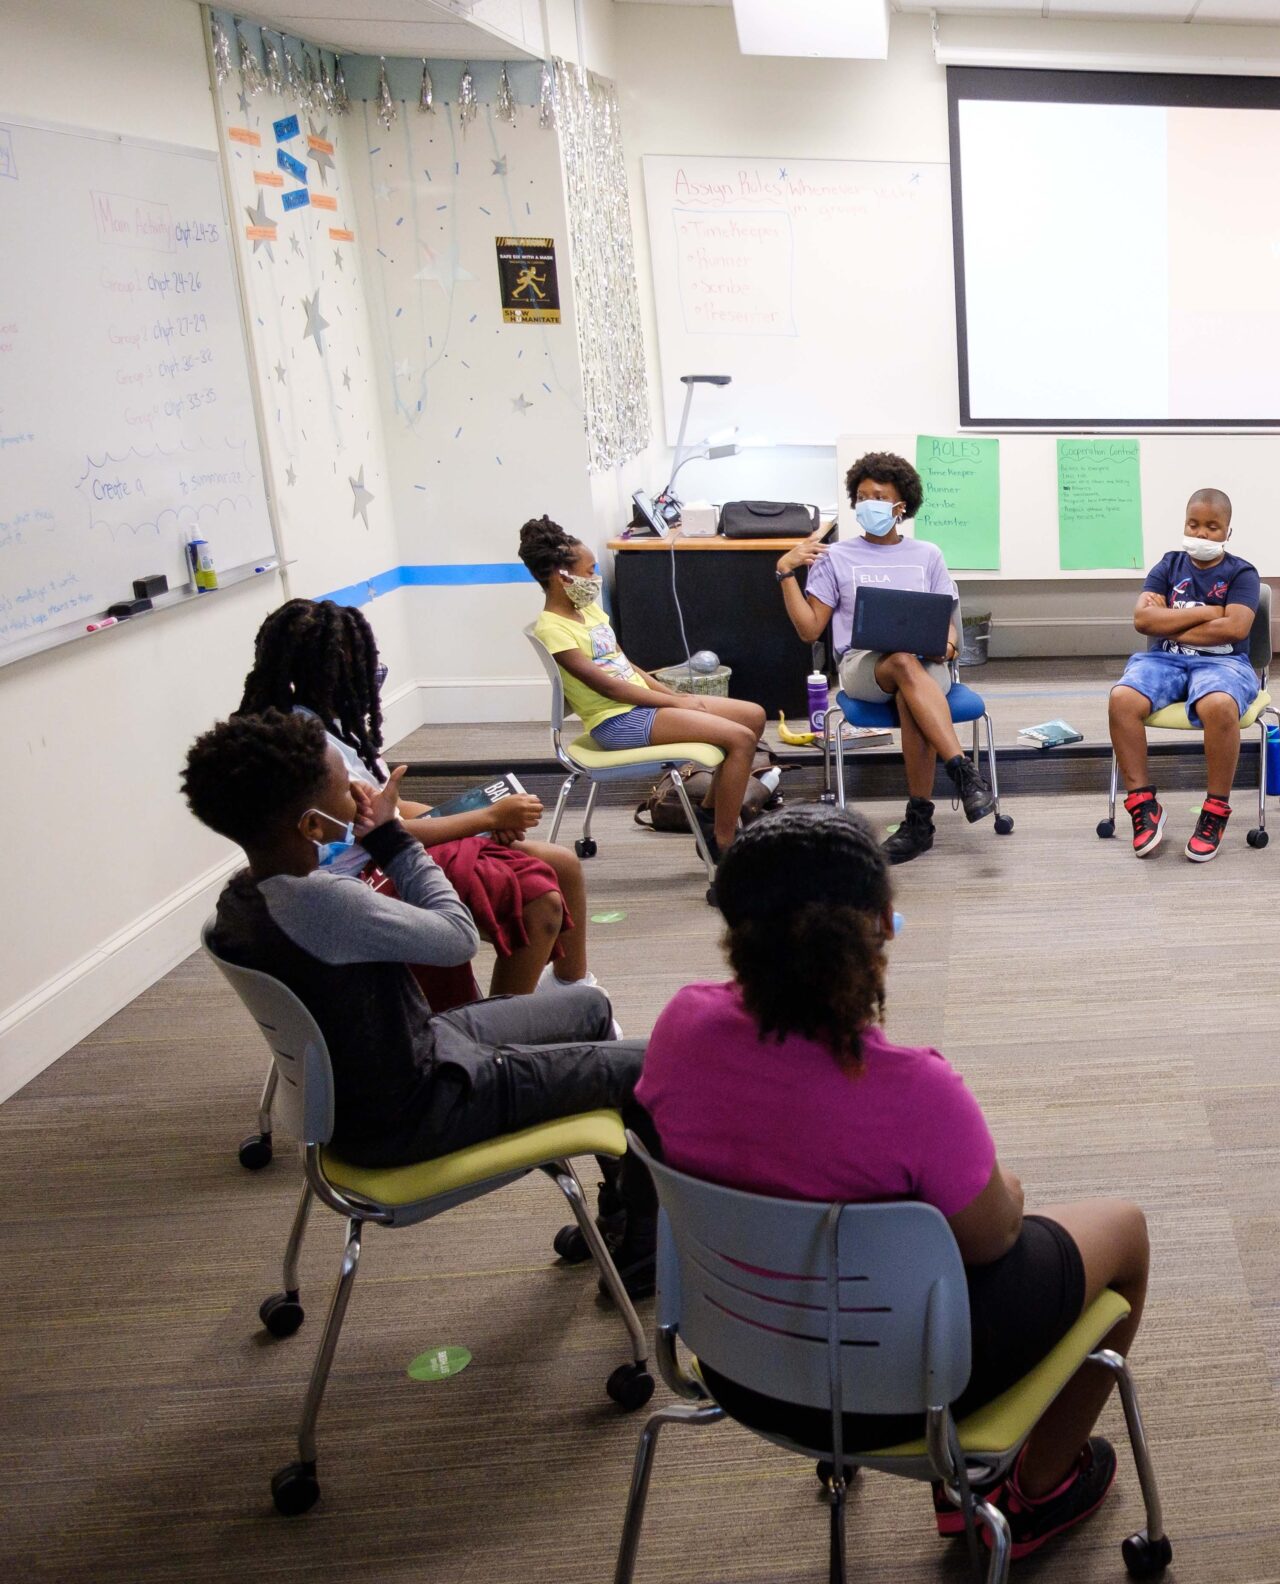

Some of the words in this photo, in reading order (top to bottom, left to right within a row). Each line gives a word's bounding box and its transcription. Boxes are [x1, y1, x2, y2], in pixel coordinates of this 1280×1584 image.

[674, 168, 733, 203] Assign
[98, 197, 128, 237] Main
[695, 247, 752, 270] Runner
[700, 278, 752, 296] Scribe
[932, 440, 980, 457] ROLES
[92, 476, 131, 500] Create
[926, 482, 961, 493] Runner
[925, 498, 956, 508] Scribe
[861, 574, 891, 584] ELLA
